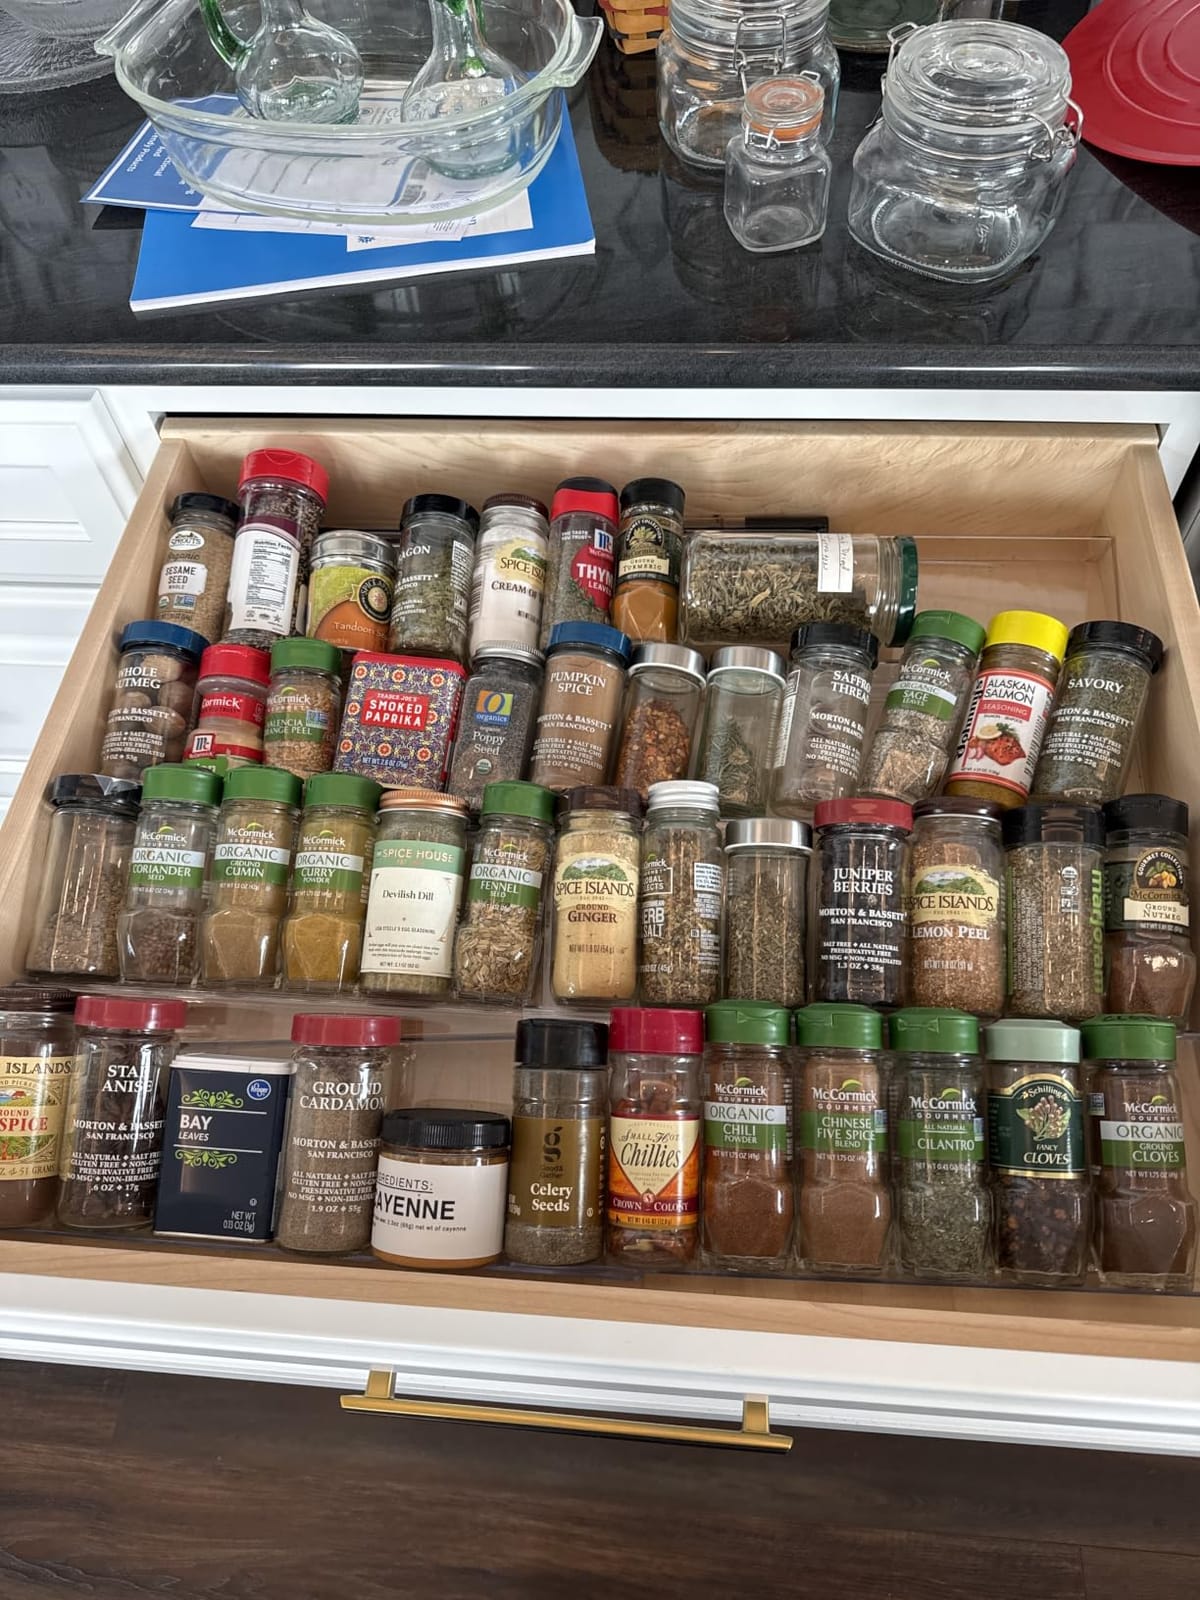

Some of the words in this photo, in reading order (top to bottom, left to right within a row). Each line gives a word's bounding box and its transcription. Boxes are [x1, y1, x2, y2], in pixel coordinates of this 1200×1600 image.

[171, 537, 201, 546] SPROUTS
[165, 565, 196, 576] SESAME
[500, 557, 530, 574] SPICE
[623, 564, 662, 572] TURMERIC
[168, 576, 188, 585] SEED
[491, 580, 526, 594] CREAM
[901, 664, 951, 682] McCormick
[550, 671, 607, 689] PUMPKIN
[1067, 678, 1125, 694] SAVORY
[557, 682, 594, 696] SPICE
[900, 681, 940, 694] ORGANIC
[988, 680, 1036, 694] ALASKAN
[902, 698, 925, 707] LEAVES
[903, 690, 929, 702] SAGE
[984, 689, 1034, 705] SALMON
[131, 707, 170, 719] BASSETT
[369, 699, 423, 714] SMOKED
[983, 703, 1028, 716] SEASONING
[365, 711, 422, 726] PAPRIKA
[475, 713, 507, 722] organics
[575, 714, 609, 731] BASSETT
[811, 712, 850, 726] MORTON
[1070, 716, 1116, 729] FRANCISCO
[1093, 709, 1130, 727] BASSETT
[291, 725, 313, 736] PEEL
[556, 721, 596, 733] FRANCISCO
[827, 722, 841, 732] SAN
[473, 731, 505, 746] Poppy
[473, 744, 500, 756] Seed
[141, 831, 187, 843] McCormick
[227, 827, 275, 840] McCormick
[303, 836, 346, 848] McCormick
[134, 850, 192, 864] ORGANIC
[219, 846, 279, 860] ORGANIC
[382, 848, 413, 859] SPICE
[416, 850, 454, 863] HOUSE
[484, 847, 529, 862] McCormick
[230, 860, 261, 868] GROUND
[297, 854, 350, 868] ORGANIC
[1137, 852, 1159, 876] GOURMET
[132, 864, 191, 877] CORIANDER
[226, 866, 265, 878] CUMIN
[301, 866, 336, 878] CURRY
[474, 866, 532, 883] ORGANIC
[833, 868, 894, 882] JUNIPER
[480, 880, 519, 894] FENNEL
[556, 881, 581, 897] SPICE
[585, 881, 634, 897] ISLANDS
[833, 881, 894, 896] BERRIES
[382, 889, 416, 900] Devilish
[418, 891, 434, 902] Dill
[575, 903, 609, 911] GROUND
[939, 895, 995, 912] ISLANDS
[1145, 903, 1177, 912] GROUND
[568, 910, 618, 924] GINGER
[819, 907, 855, 916] MORTON
[857, 908, 867, 917] &
[868, 909, 905, 921] BASSETT
[1143, 909, 1181, 921] NUTMEG
[847, 918, 893, 928] FRANCISCO
[643, 924, 664, 938] SALT
[912, 926, 953, 938] LEMON
[958, 925, 990, 940] PEEL
[849, 962, 861, 970] OZ
[5, 1061, 71, 1074] ISLANDS
[101, 1080, 153, 1093] ANISE
[250, 1083, 269, 1097] Kroger
[312, 1081, 382, 1096] GROUND
[714, 1083, 768, 1098] McCormick
[1027, 1086, 1063, 1098] Schilling
[812, 1087, 877, 1102] McCormick
[818, 1103, 874, 1112] GOURMET
[909, 1096, 976, 1112] McCormick
[1122, 1102, 1177, 1113] McCormick
[710, 1105, 775, 1122] ORGANIC
[916, 1112, 972, 1120] GOURMET
[73, 1119, 116, 1131] MORTON
[118, 1122, 127, 1131] &
[180, 1114, 213, 1130] BAY
[822, 1117, 872, 1129] CHINESE
[86, 1132, 104, 1140] SAN
[178, 1132, 210, 1142] LEAVES
[723, 1125, 756, 1136] CHILI
[817, 1128, 842, 1139] FIVE
[846, 1129, 876, 1141] SPICE
[1116, 1125, 1184, 1139] ORGANIC
[292, 1136, 337, 1149] MORTON
[339, 1140, 349, 1149] &
[724, 1135, 758, 1144] POWDER
[834, 1140, 861, 1148] BLEND
[917, 1138, 974, 1151] CILANTRO
[1140, 1143, 1173, 1151] GROUND
[84, 1153, 121, 1161] NATURAL
[307, 1150, 325, 1158] SAN
[327, 1150, 374, 1159] FRANCISCO
[621, 1142, 681, 1168] Chillies
[1023, 1152, 1070, 1165] CLOVES
[1132, 1150, 1179, 1162] CLOVES
[71, 1159, 98, 1167] GLUTEN
[79, 1167, 136, 1175] PRESERVATIVE
[305, 1172, 342, 1180] NATURAL
[100, 1184, 115, 1192] OZ
[125, 1184, 139, 1192] 17g
[291, 1178, 320, 1187] GLUTEN
[288, 1191, 298, 1199] NO
[298, 1193, 316, 1201] MSG
[301, 1187, 357, 1195] PRESERVATIVE
[530, 1183, 573, 1199] Celery
[532, 1199, 570, 1212] Seeds
[613, 1198, 642, 1210] CROWN
[231, 1211, 244, 1220] NET
[245, 1212, 256, 1221] WT
[223, 1220, 235, 1230] 0.13
[235, 1221, 244, 1230] OZ
[244, 1221, 256, 1234] (3g)
